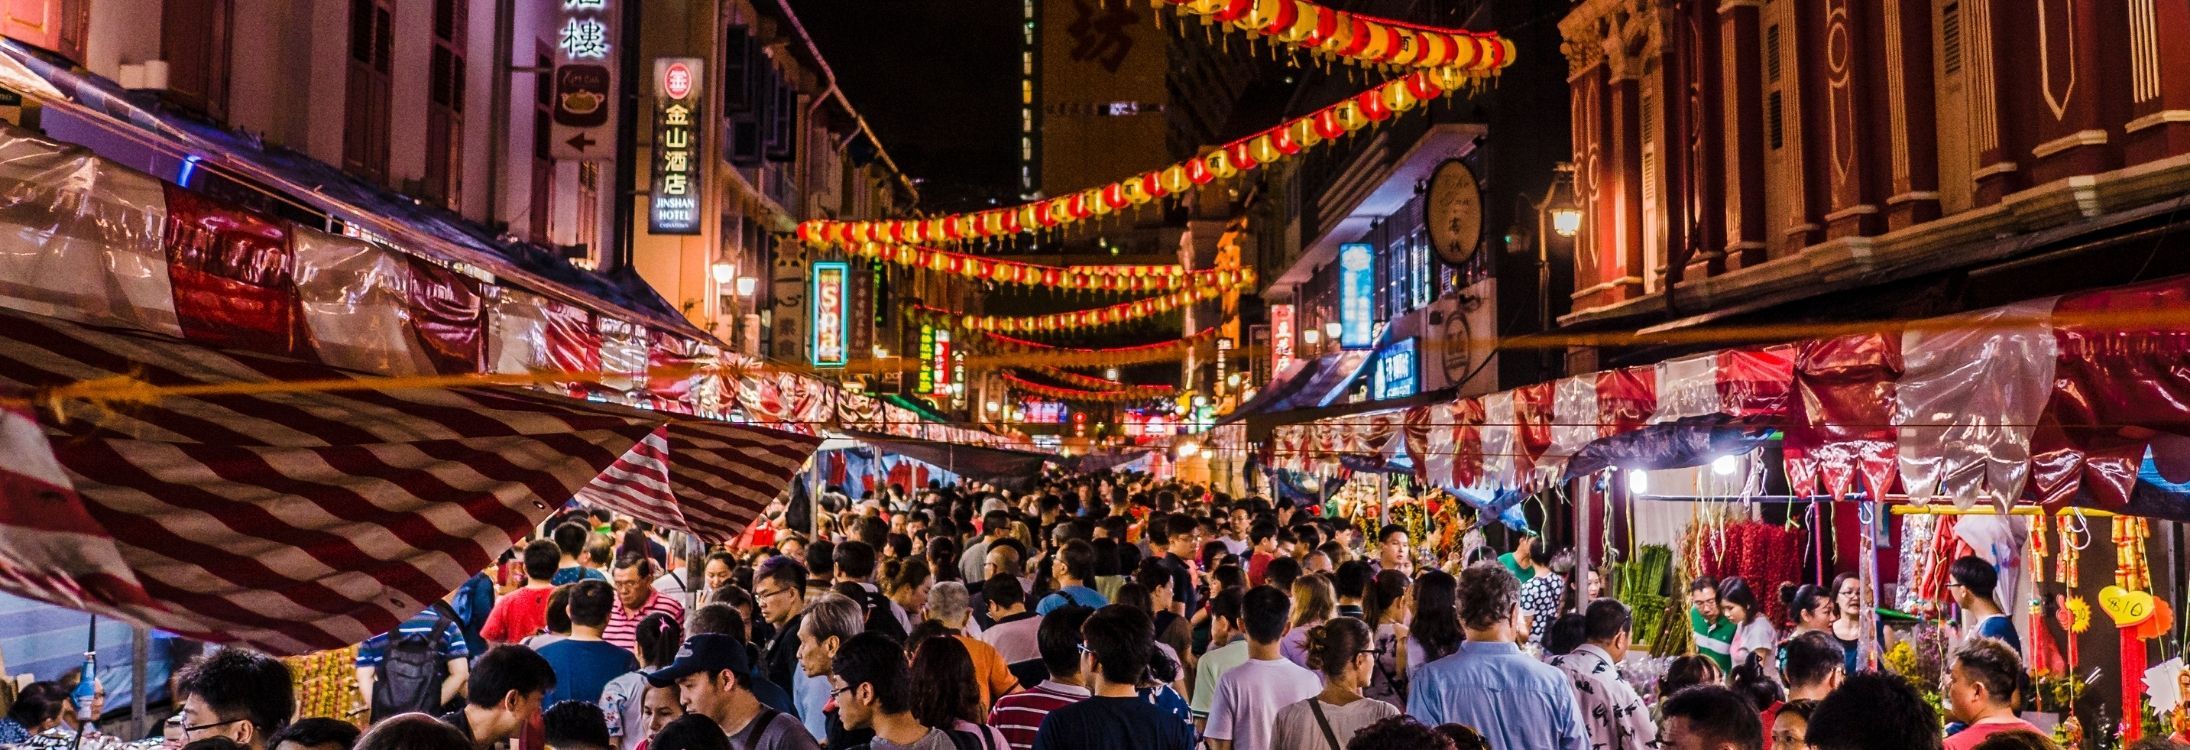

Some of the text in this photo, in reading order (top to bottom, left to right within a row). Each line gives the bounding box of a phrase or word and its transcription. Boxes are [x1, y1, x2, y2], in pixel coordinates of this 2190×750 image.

[559, 0, 610, 58] 樓
[669, 69, 688, 92] 金
[664, 104, 688, 195] 金山酒店
[656, 198, 695, 209] JINSHAN
[659, 210, 690, 221] HOTEL
[819, 283, 840, 349] Spa
